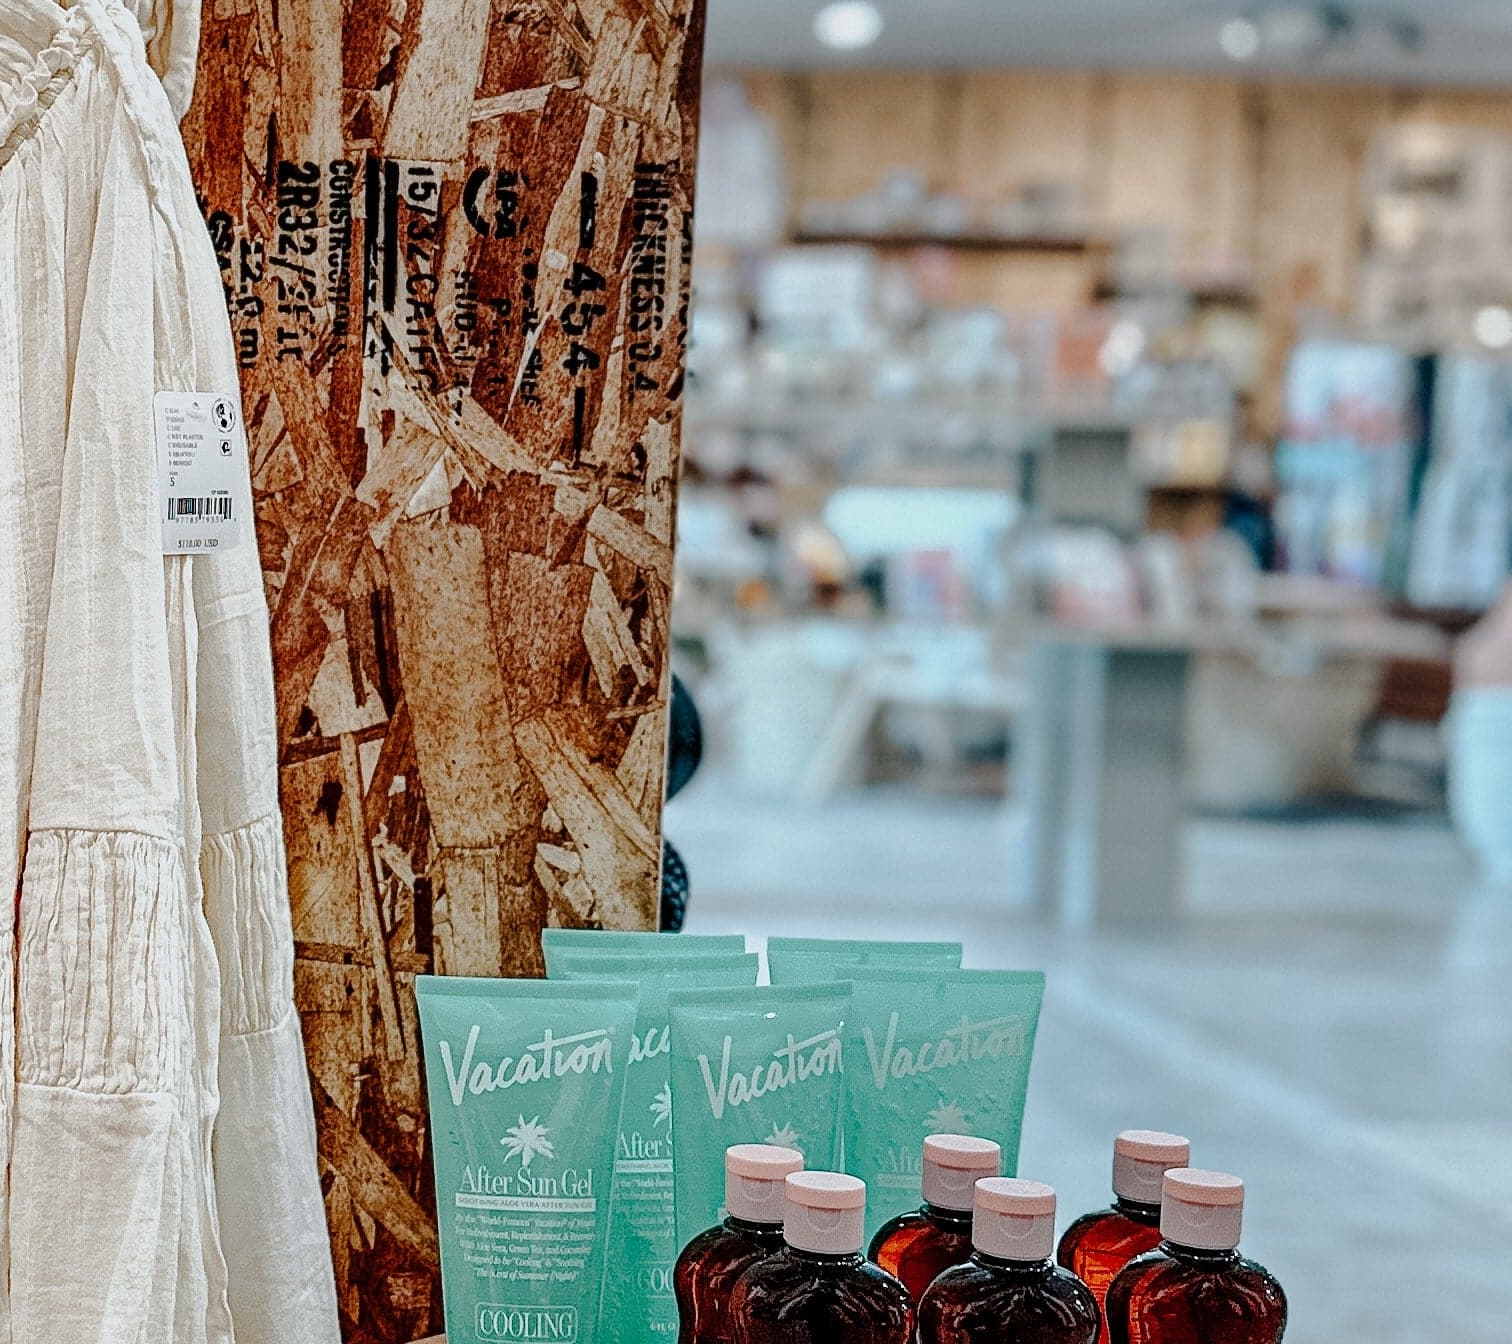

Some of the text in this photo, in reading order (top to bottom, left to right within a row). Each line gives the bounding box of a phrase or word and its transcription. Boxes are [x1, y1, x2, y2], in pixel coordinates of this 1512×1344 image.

[558, 262, 606, 377] 454
[439, 1025, 616, 1106] Vacation
[696, 1028, 844, 1120] Vacation
[862, 1011, 1027, 1090] Vacation
[459, 1165, 593, 1197] After Sun Gel
[480, 1309, 573, 1339] COOLING
